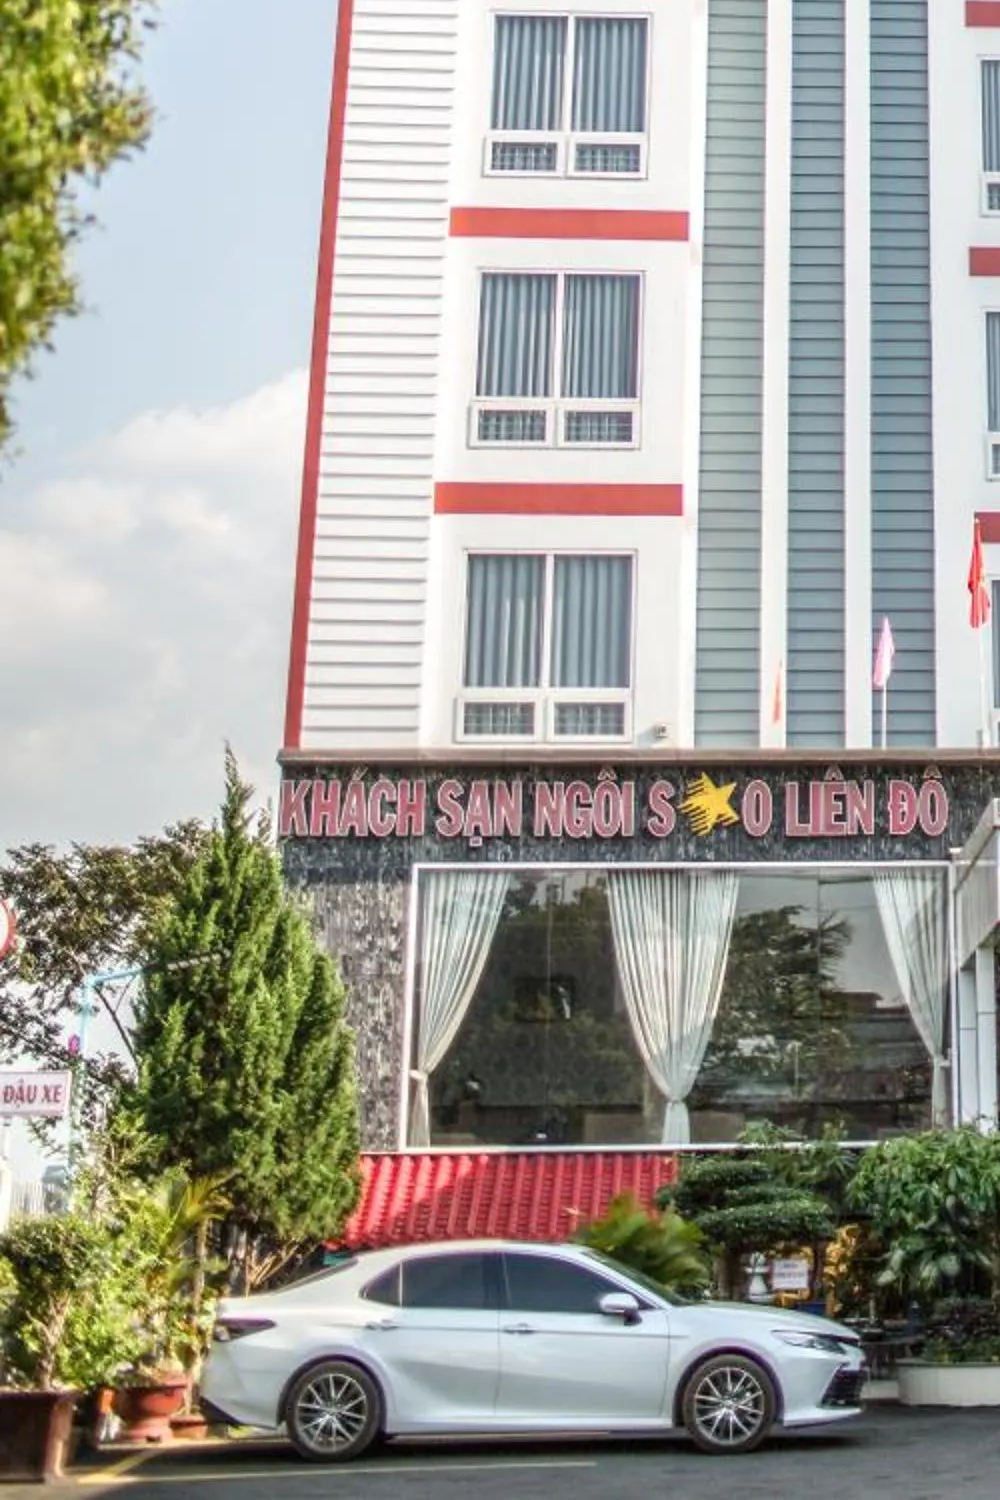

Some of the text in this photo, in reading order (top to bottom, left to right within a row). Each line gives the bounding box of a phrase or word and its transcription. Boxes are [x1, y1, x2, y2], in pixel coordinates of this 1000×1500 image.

[278, 765, 950, 847] KHÁCH SẠN NGÔI SO LIÊN ĐÔ
[41, 1083, 63, 1103] XE
